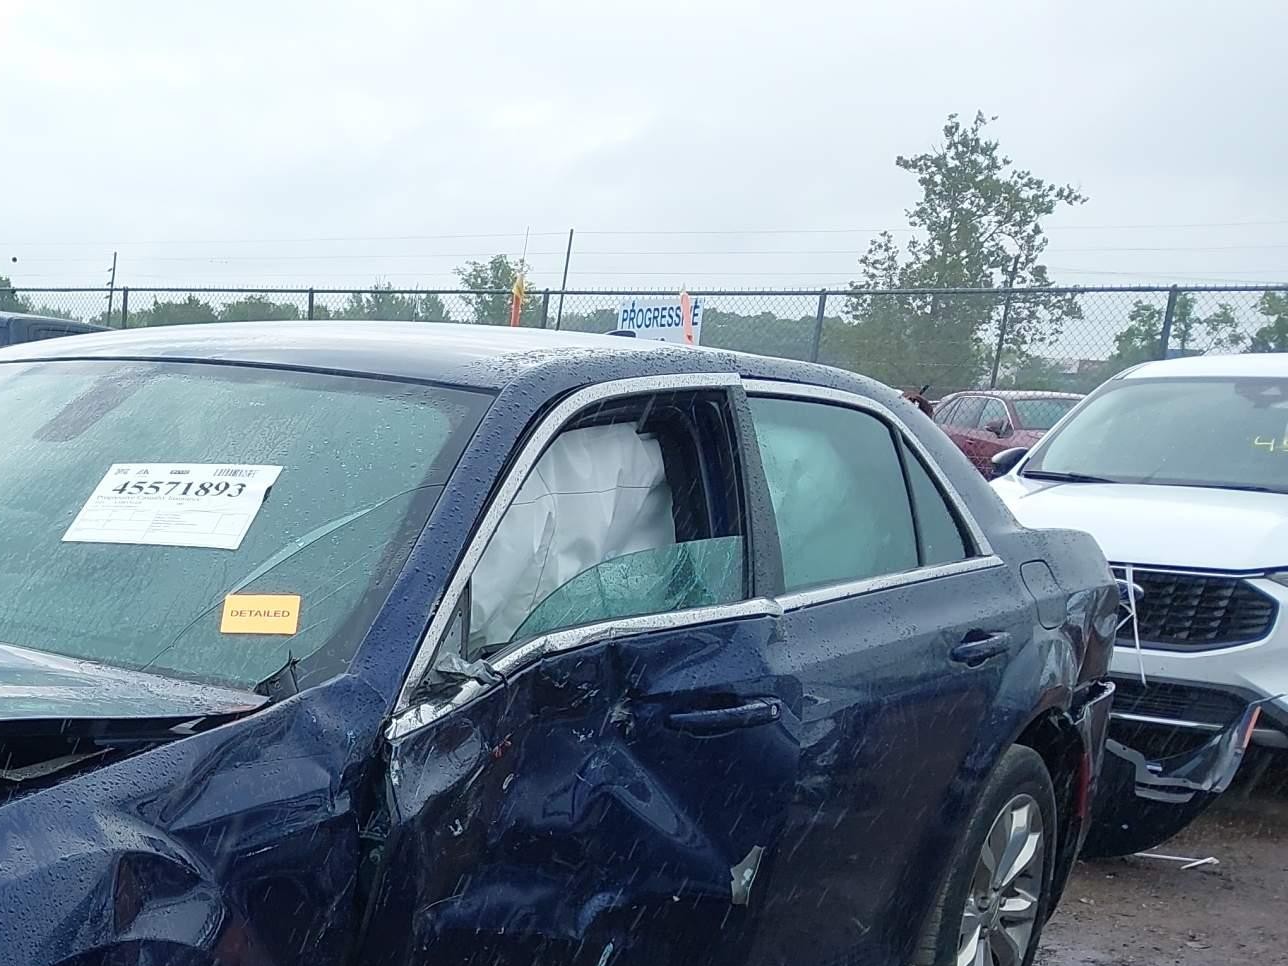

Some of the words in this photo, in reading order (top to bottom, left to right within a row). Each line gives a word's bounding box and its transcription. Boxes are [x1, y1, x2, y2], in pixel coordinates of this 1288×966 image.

[620, 304, 700, 330] PROGRESSIE
[112, 480, 247, 498] 45571893
[230, 609, 291, 618] DETAILED
